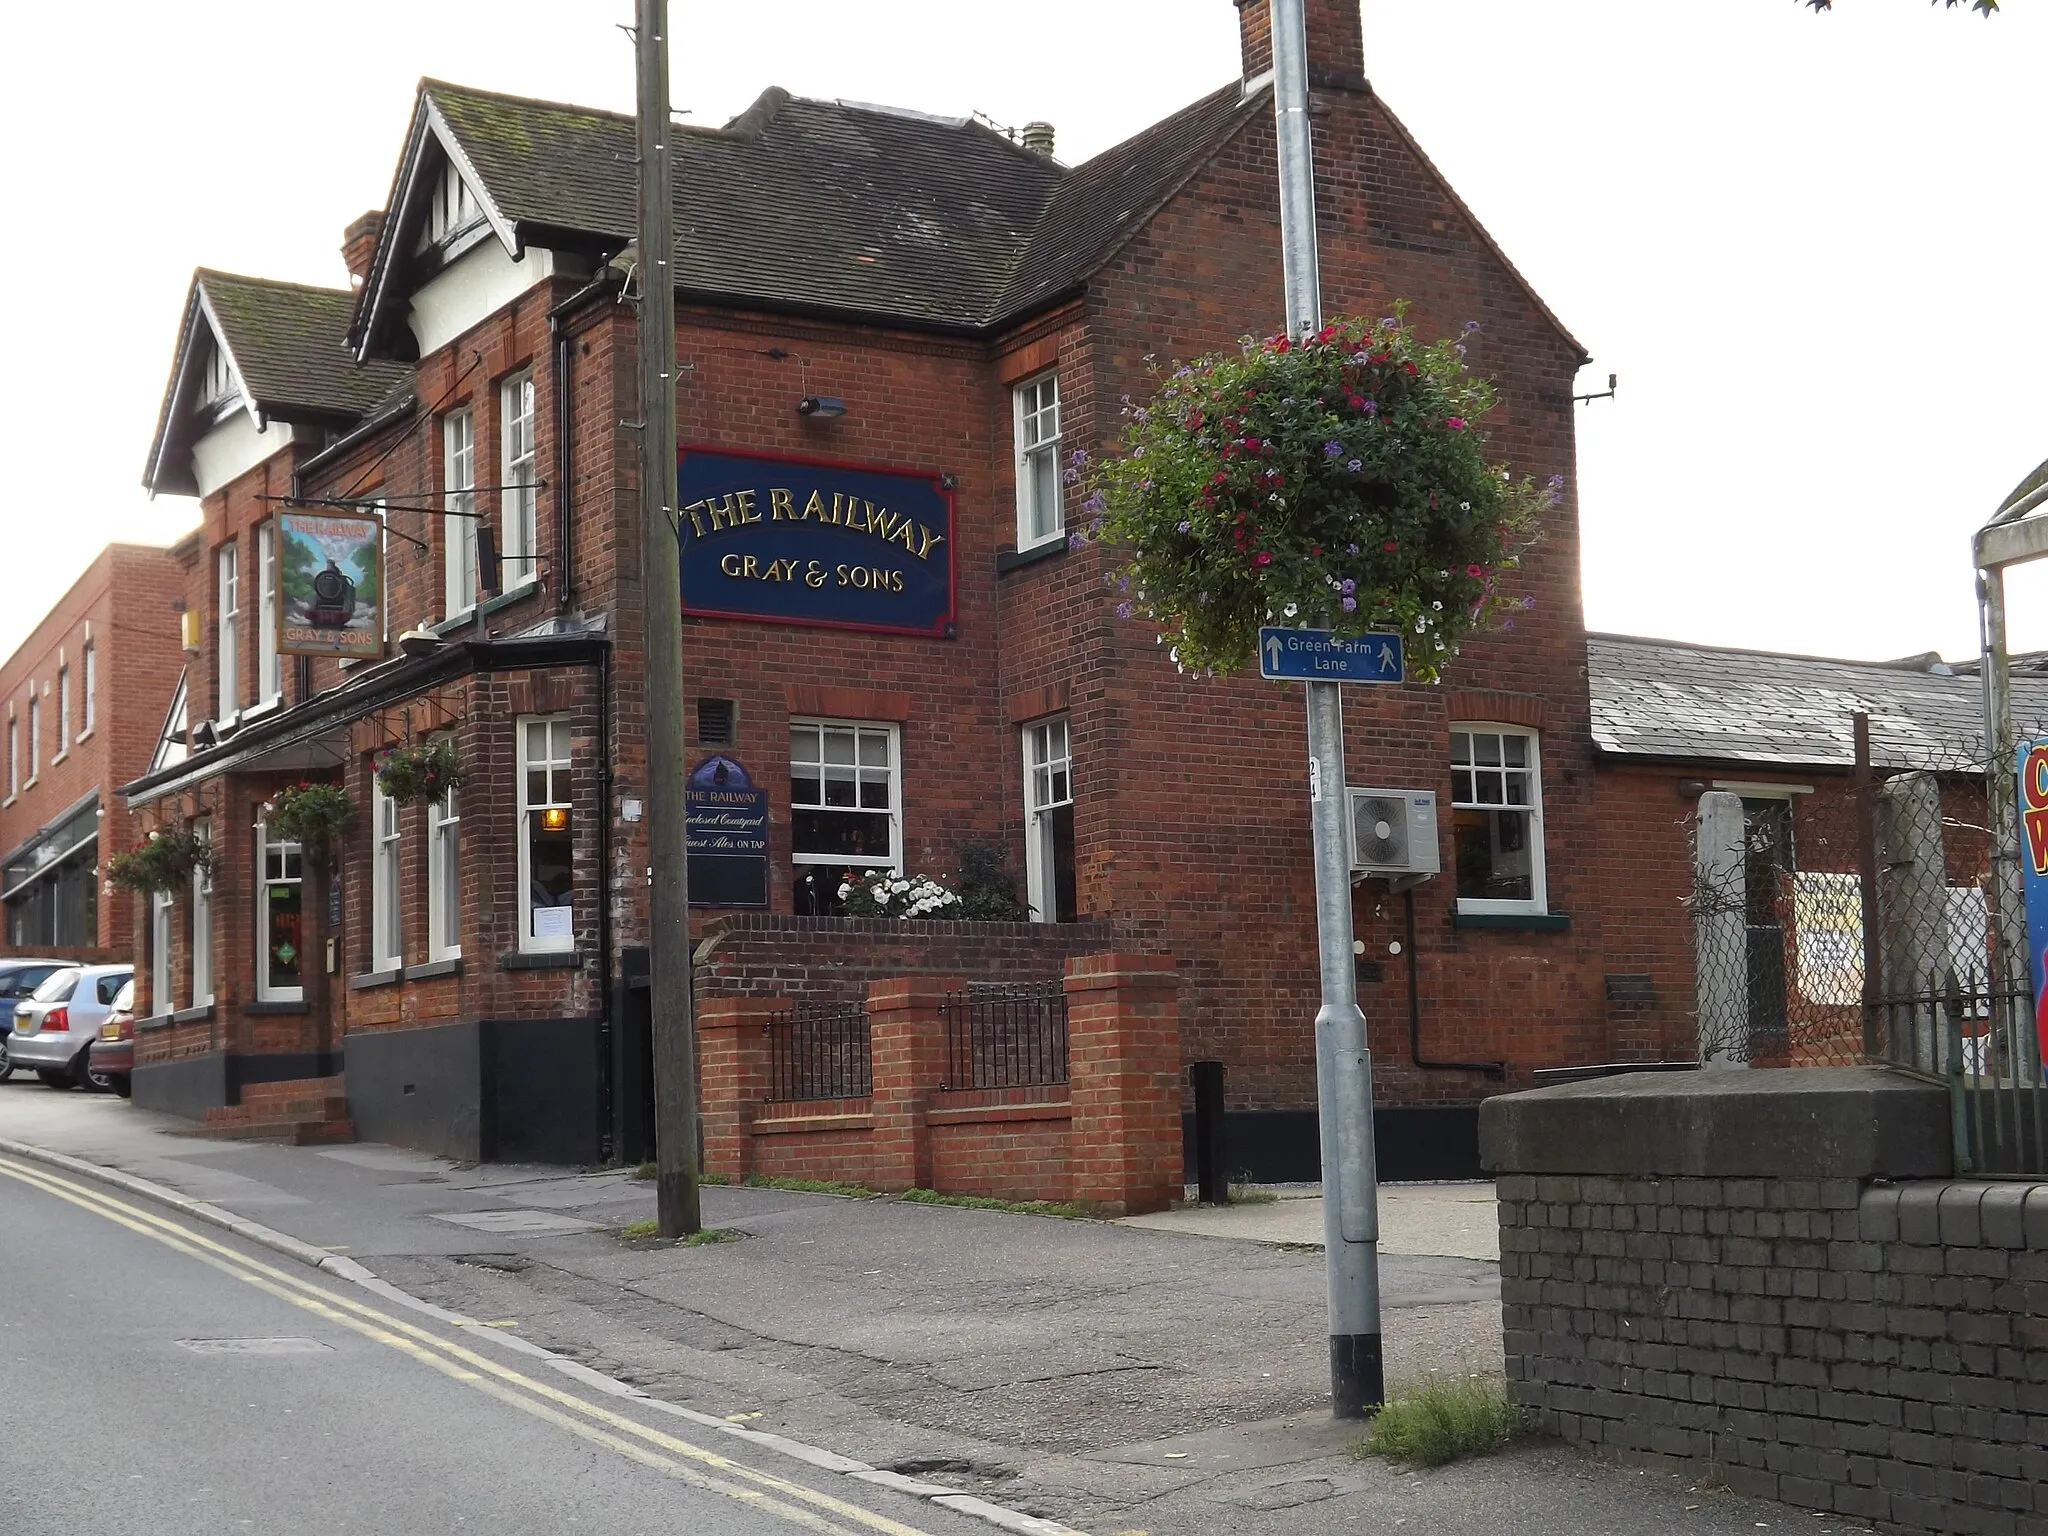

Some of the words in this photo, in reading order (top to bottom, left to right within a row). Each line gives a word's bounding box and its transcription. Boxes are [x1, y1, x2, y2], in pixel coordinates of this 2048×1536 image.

[289, 520, 313, 534] THE
[679, 488, 762, 538] THE
[769, 487, 946, 560] RAILWAY
[721, 554, 799, 582] GRAY
[805, 560, 828, 588] &
[836, 564, 904, 592] SONS
[286, 628, 321, 641] GRAY
[340, 631, 373, 645] SONS
[1287, 637, 1331, 653] Green
[1315, 656, 1348, 671] Lane
[685, 790, 705, 801] THE
[710, 791, 758, 803] RAILWAY
[685, 812, 720, 825] nclosed
[720, 813, 764, 829] Courtyard
[709, 836, 733, 848] Ales
[737, 840, 749, 849] ON
[750, 840, 765, 849] TAP
